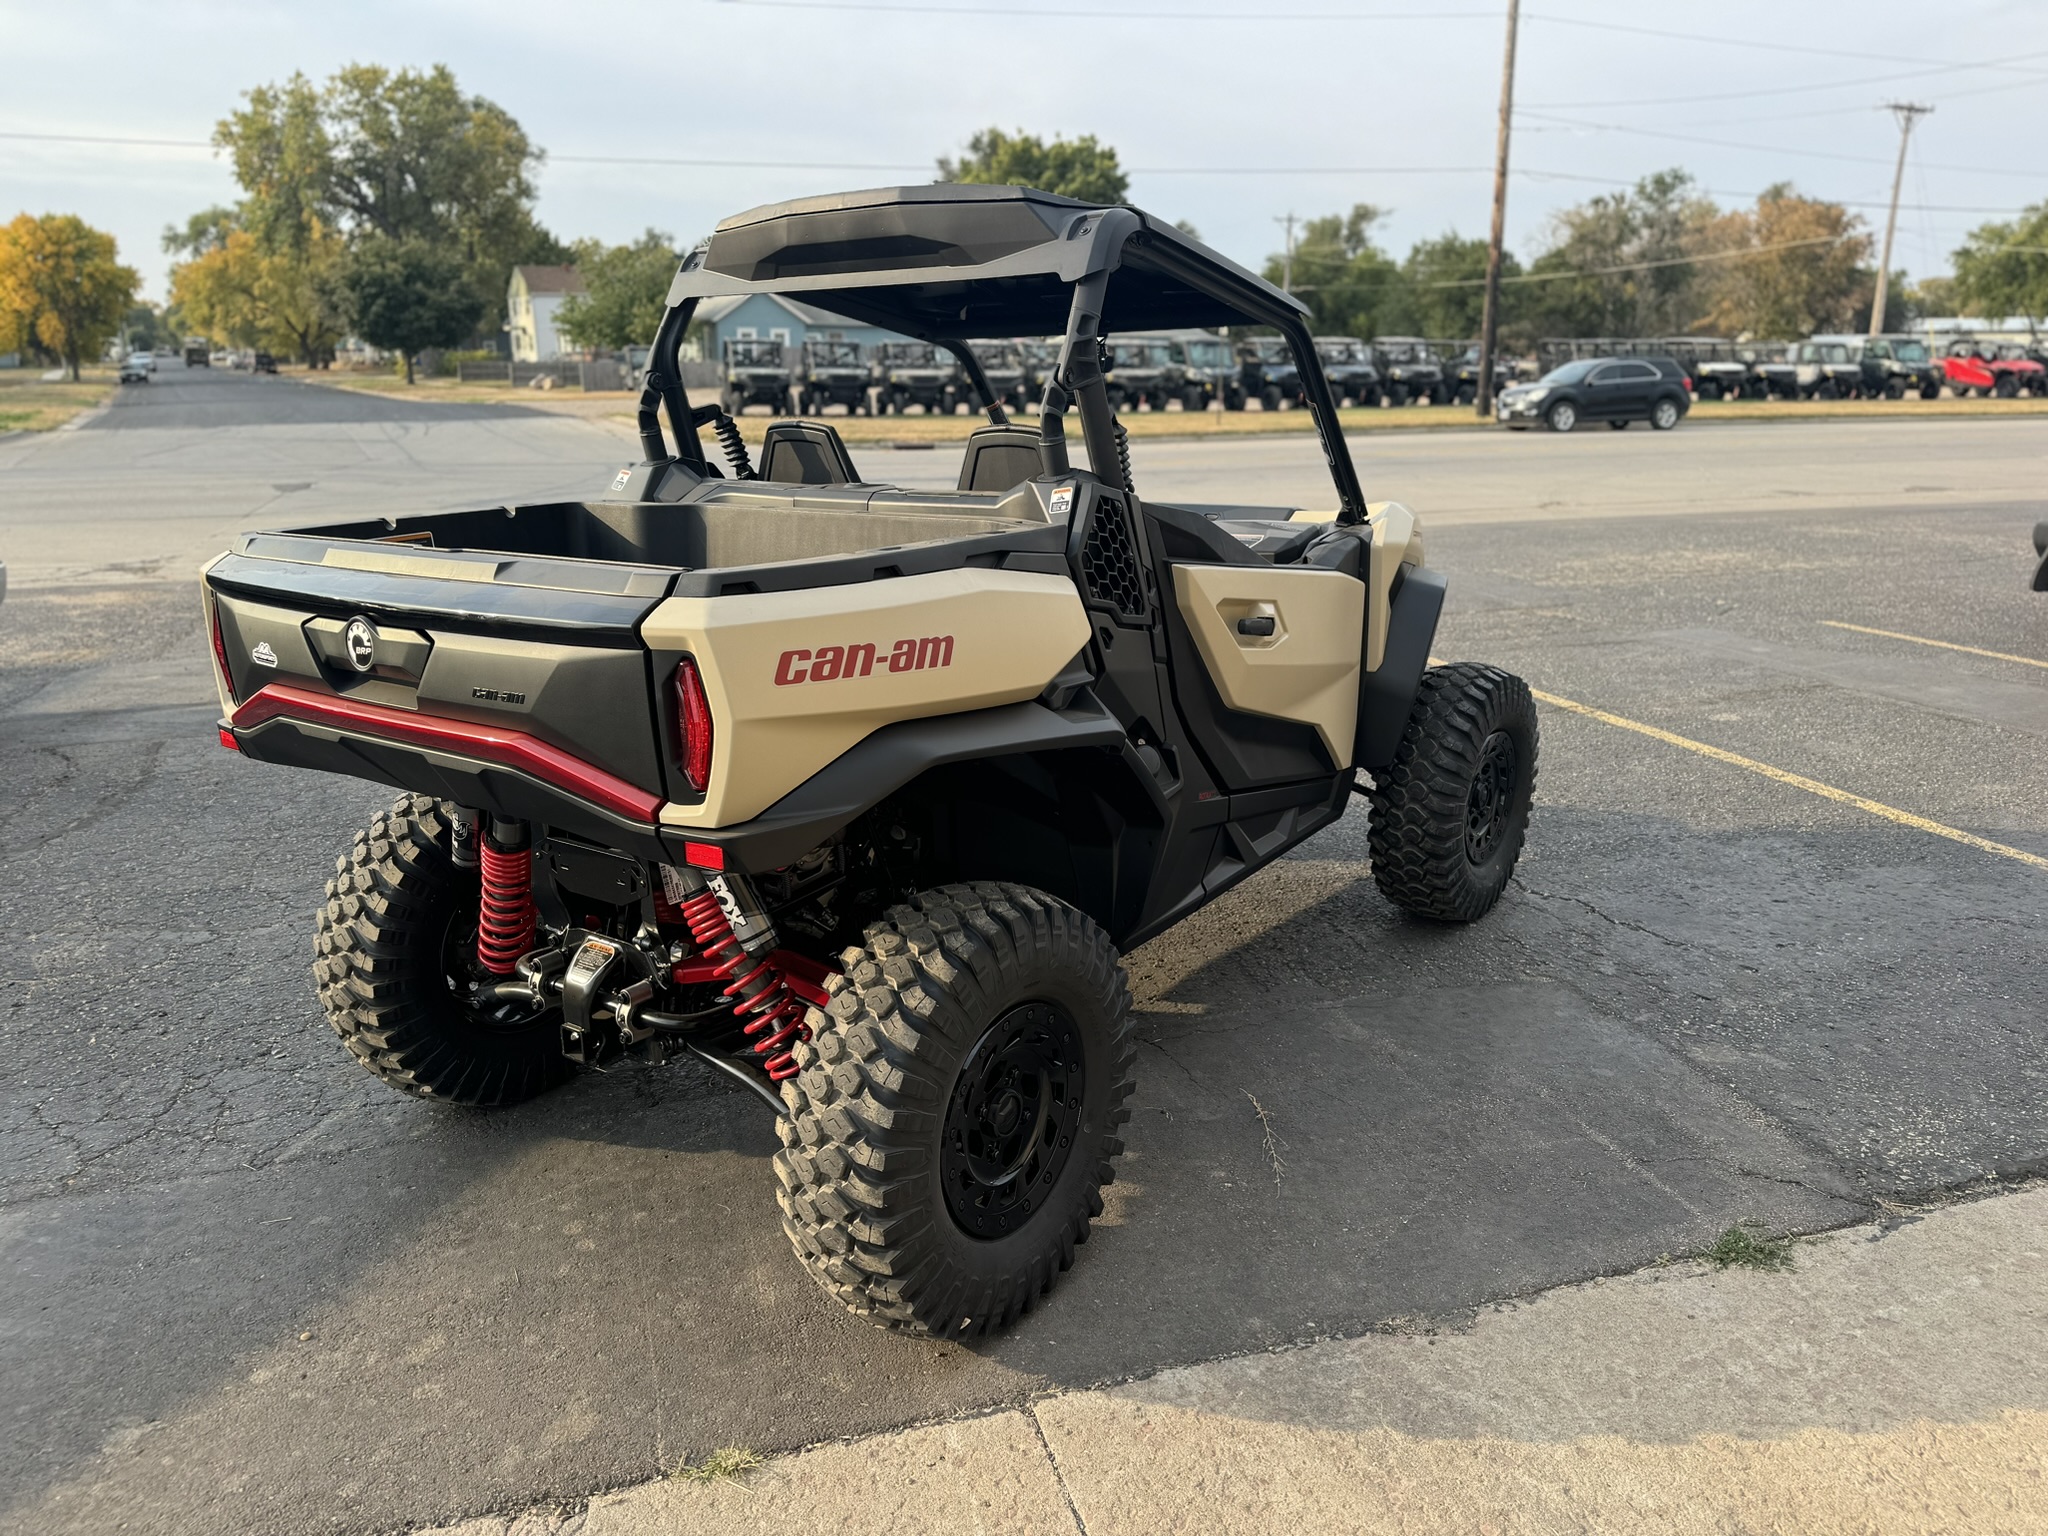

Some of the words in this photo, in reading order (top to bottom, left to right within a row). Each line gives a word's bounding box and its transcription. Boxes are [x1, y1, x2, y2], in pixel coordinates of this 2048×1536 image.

[355, 646, 372, 655] BRP
[774, 636, 954, 686] can-am
[472, 686, 525, 704] can-am
[708, 875, 747, 930] FOX
